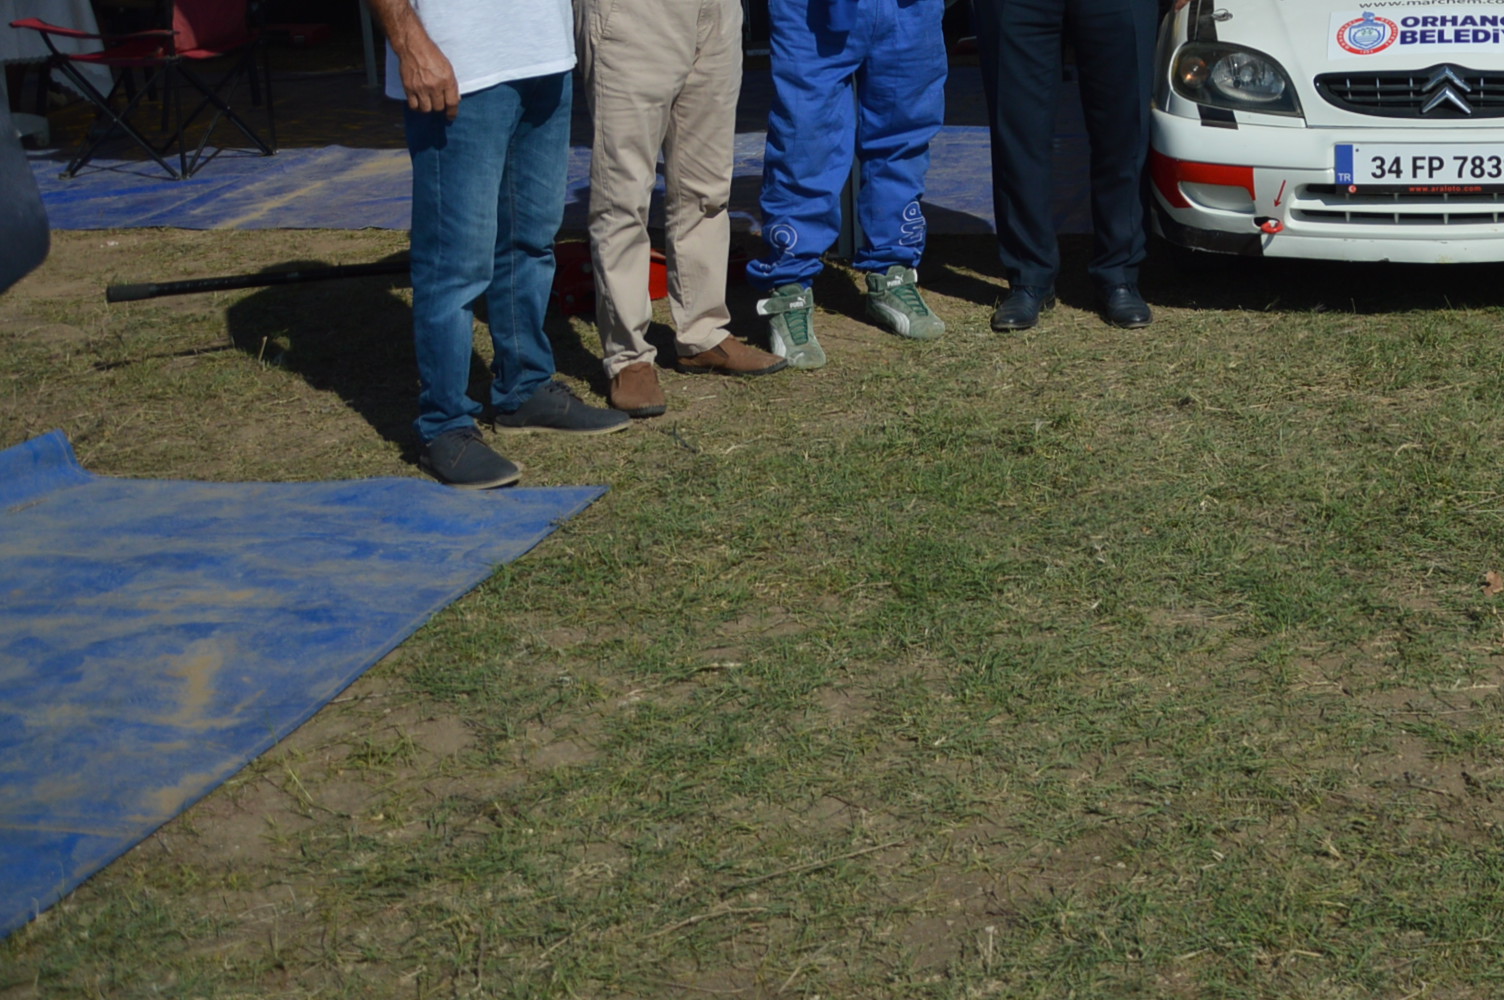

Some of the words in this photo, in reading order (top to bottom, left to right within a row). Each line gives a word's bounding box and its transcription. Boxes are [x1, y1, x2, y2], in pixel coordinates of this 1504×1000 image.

[1371, 156, 1403, 179] 34
[1412, 156, 1445, 179] FP
[1338, 173, 1351, 182] TR
[1408, 184, 1482, 193] www.araloto.com
